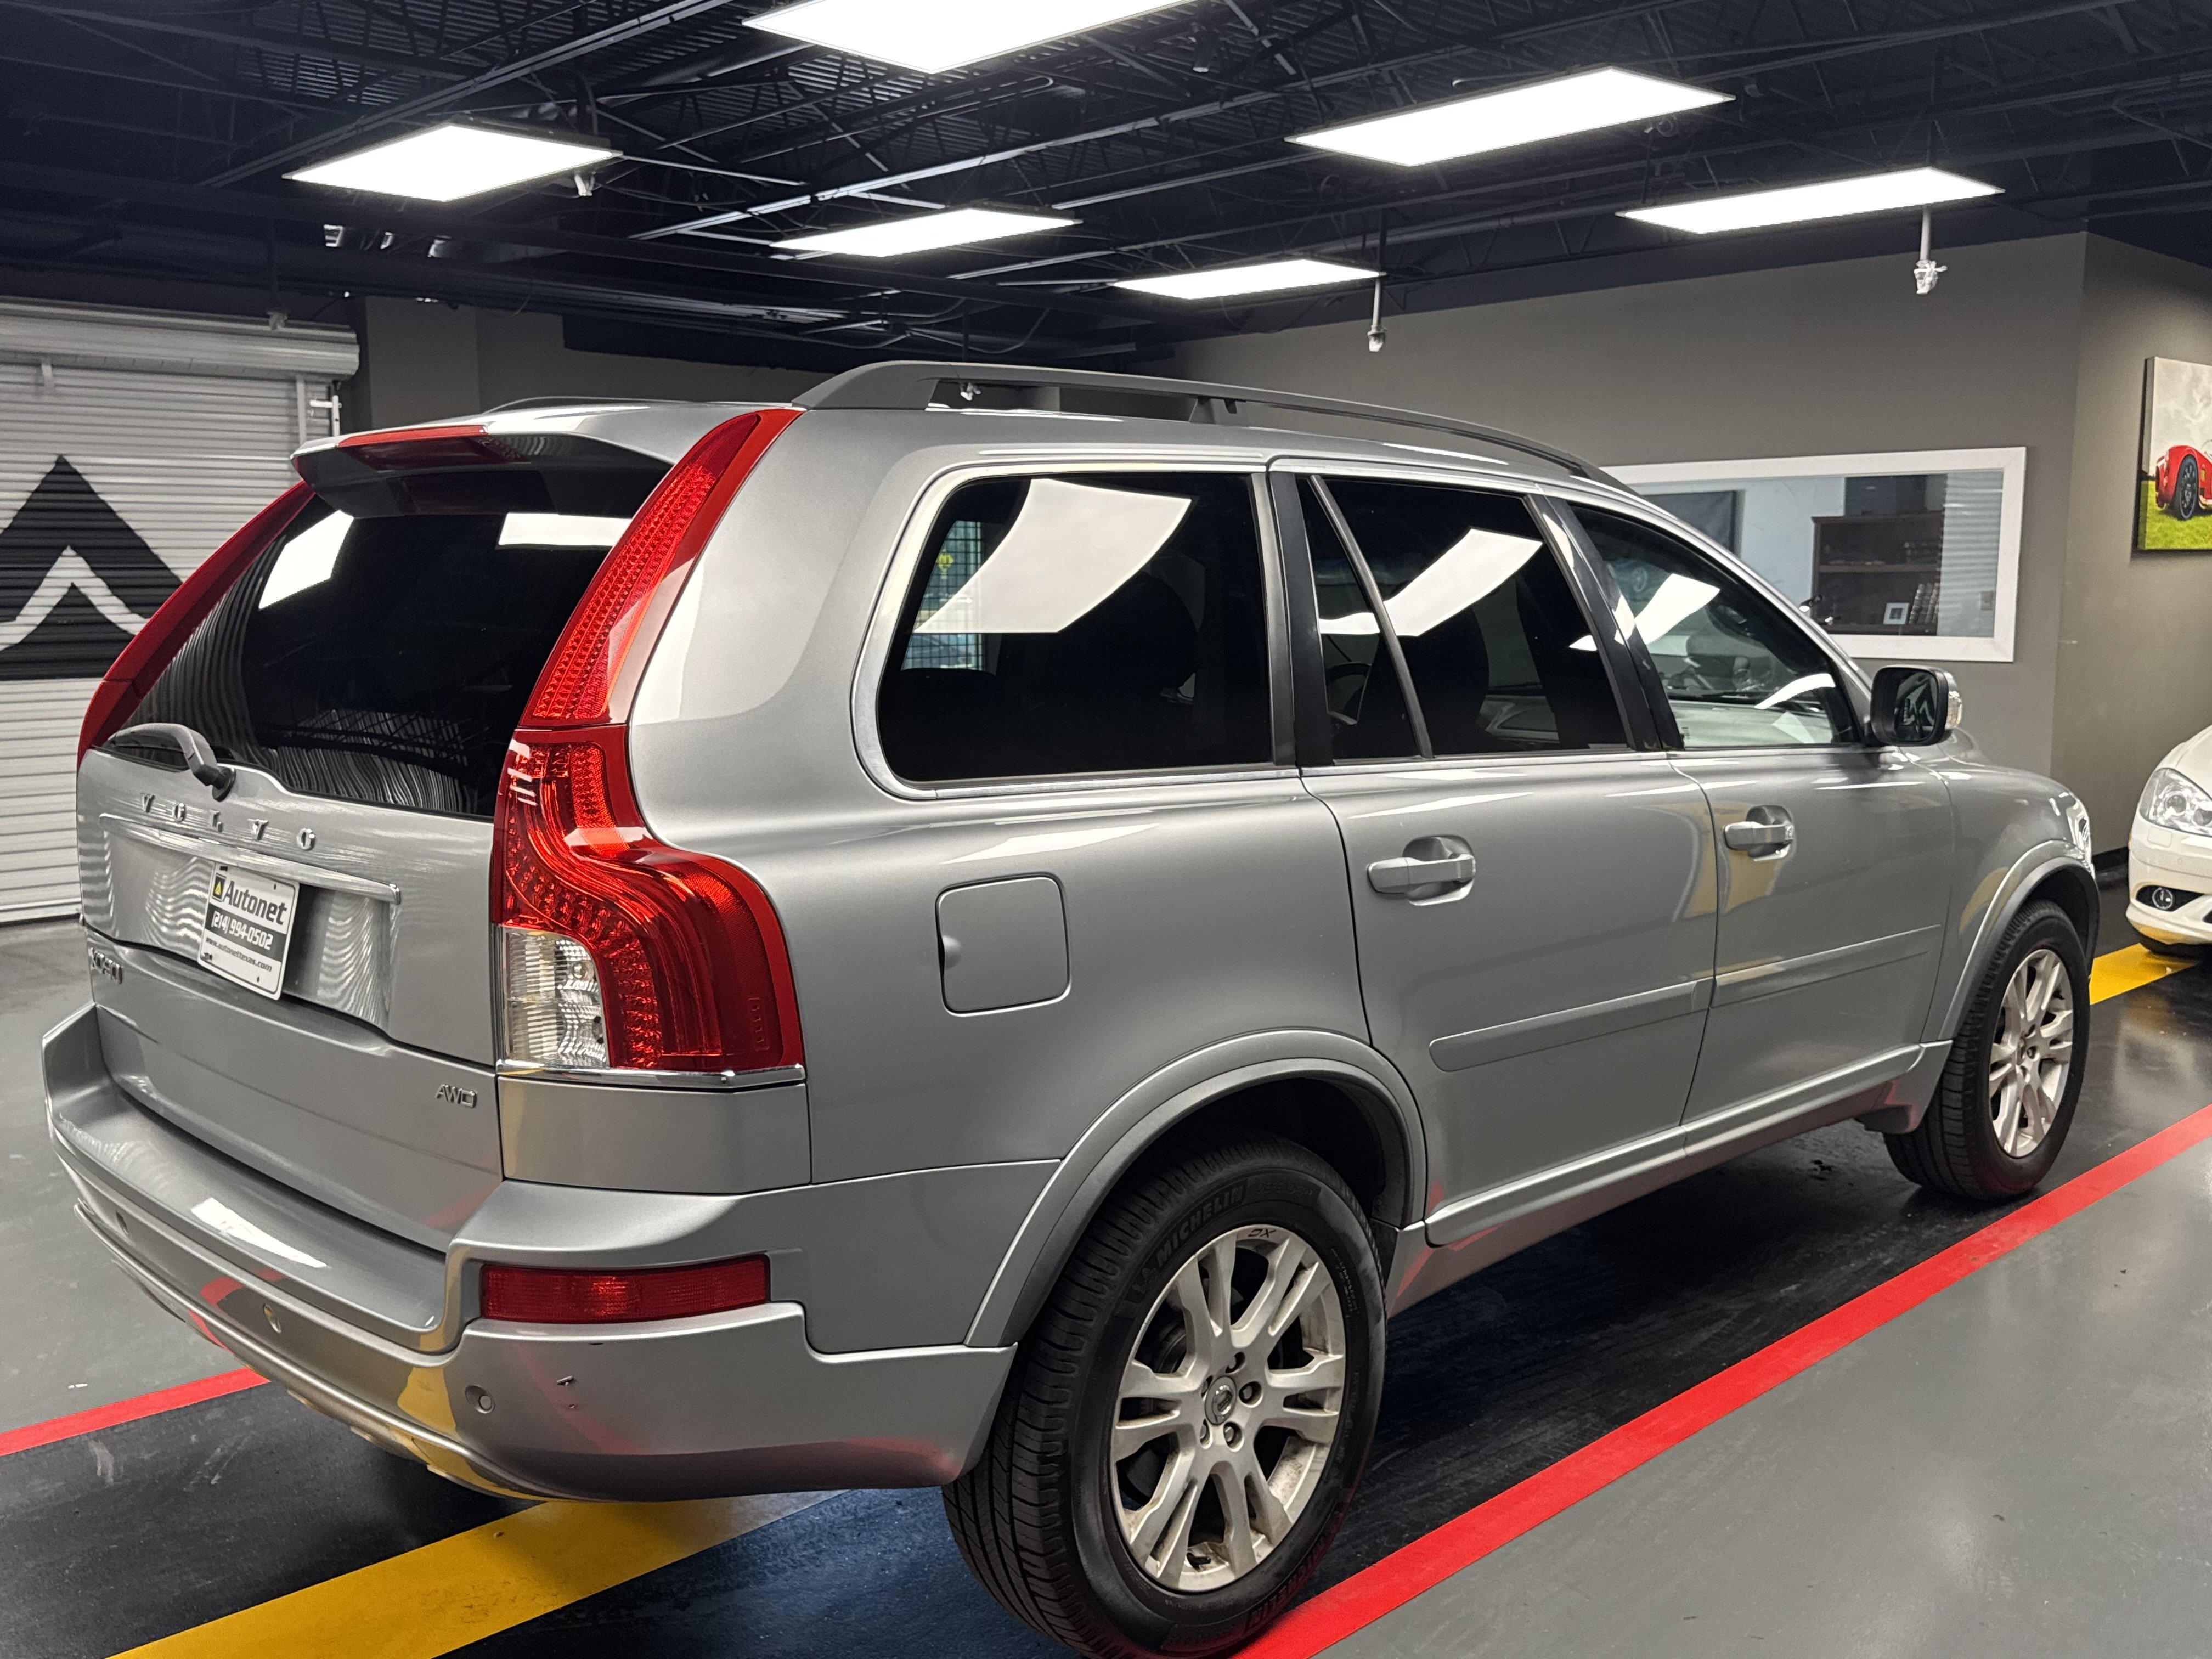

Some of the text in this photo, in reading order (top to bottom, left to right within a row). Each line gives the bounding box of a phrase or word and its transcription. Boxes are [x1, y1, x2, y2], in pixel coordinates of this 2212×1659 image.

[140, 793, 317, 851] VOLVO
[222, 881, 287, 926] Autonet
[211, 910, 274, 951] (214) 994-0502
[435, 1084, 477, 1108] AWD
[1155, 1184, 1244, 1268] MICHELIN
